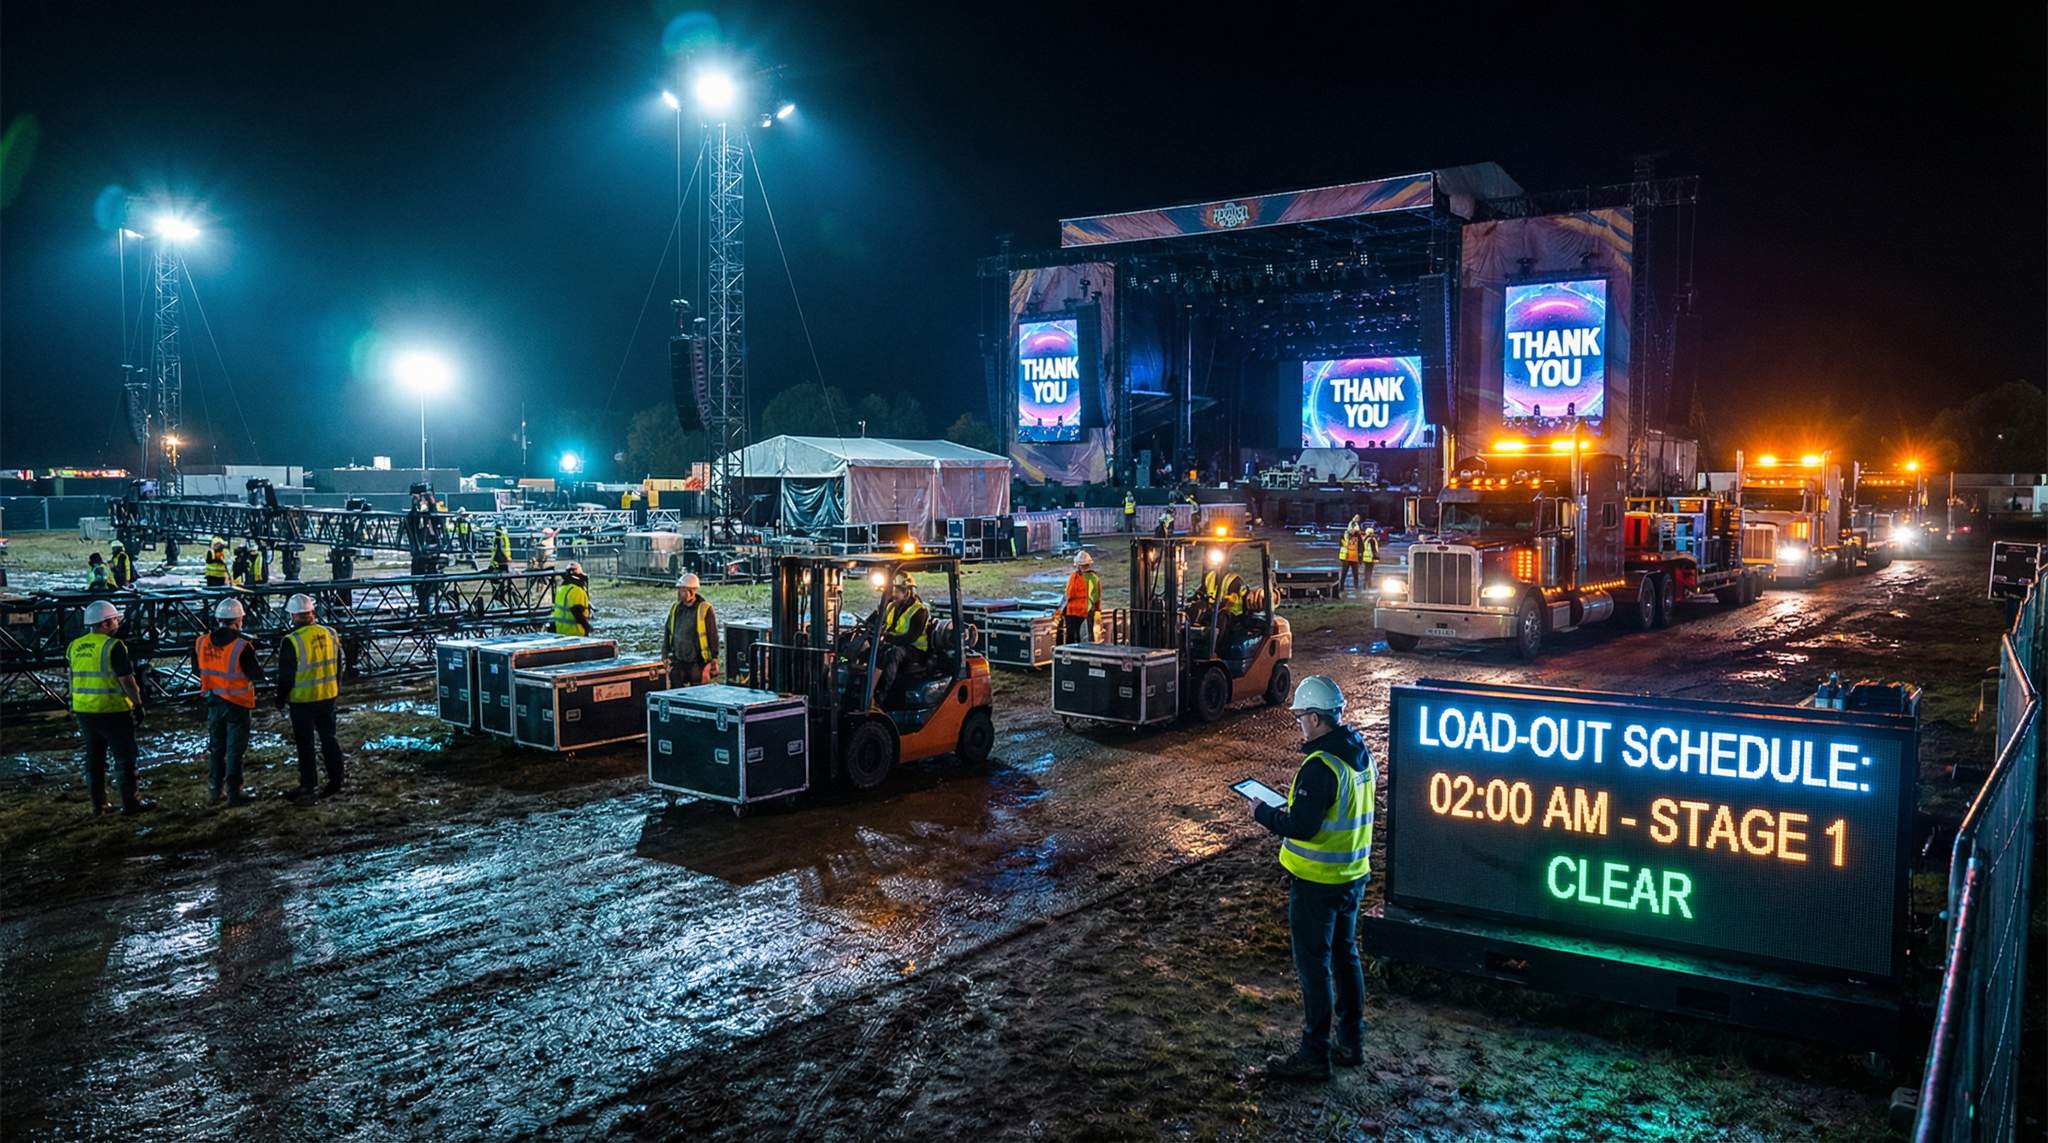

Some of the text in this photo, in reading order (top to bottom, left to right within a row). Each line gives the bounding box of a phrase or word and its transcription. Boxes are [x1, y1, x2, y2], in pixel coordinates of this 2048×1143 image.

[1507, 327, 1601, 360] THANK
[1021, 356, 1079, 381] THANK
[1524, 358, 1582, 388] YOU
[1032, 380, 1067, 404] YOU
[1330, 376, 1405, 403] THANK
[1343, 403, 1389, 428] YOU
[1419, 705, 1872, 793] LOAD-OUT SCHEDULE:
[1429, 772, 1847, 868] 02:00 AM - STAGE 1
[1547, 855, 1694, 920] CLEAR
